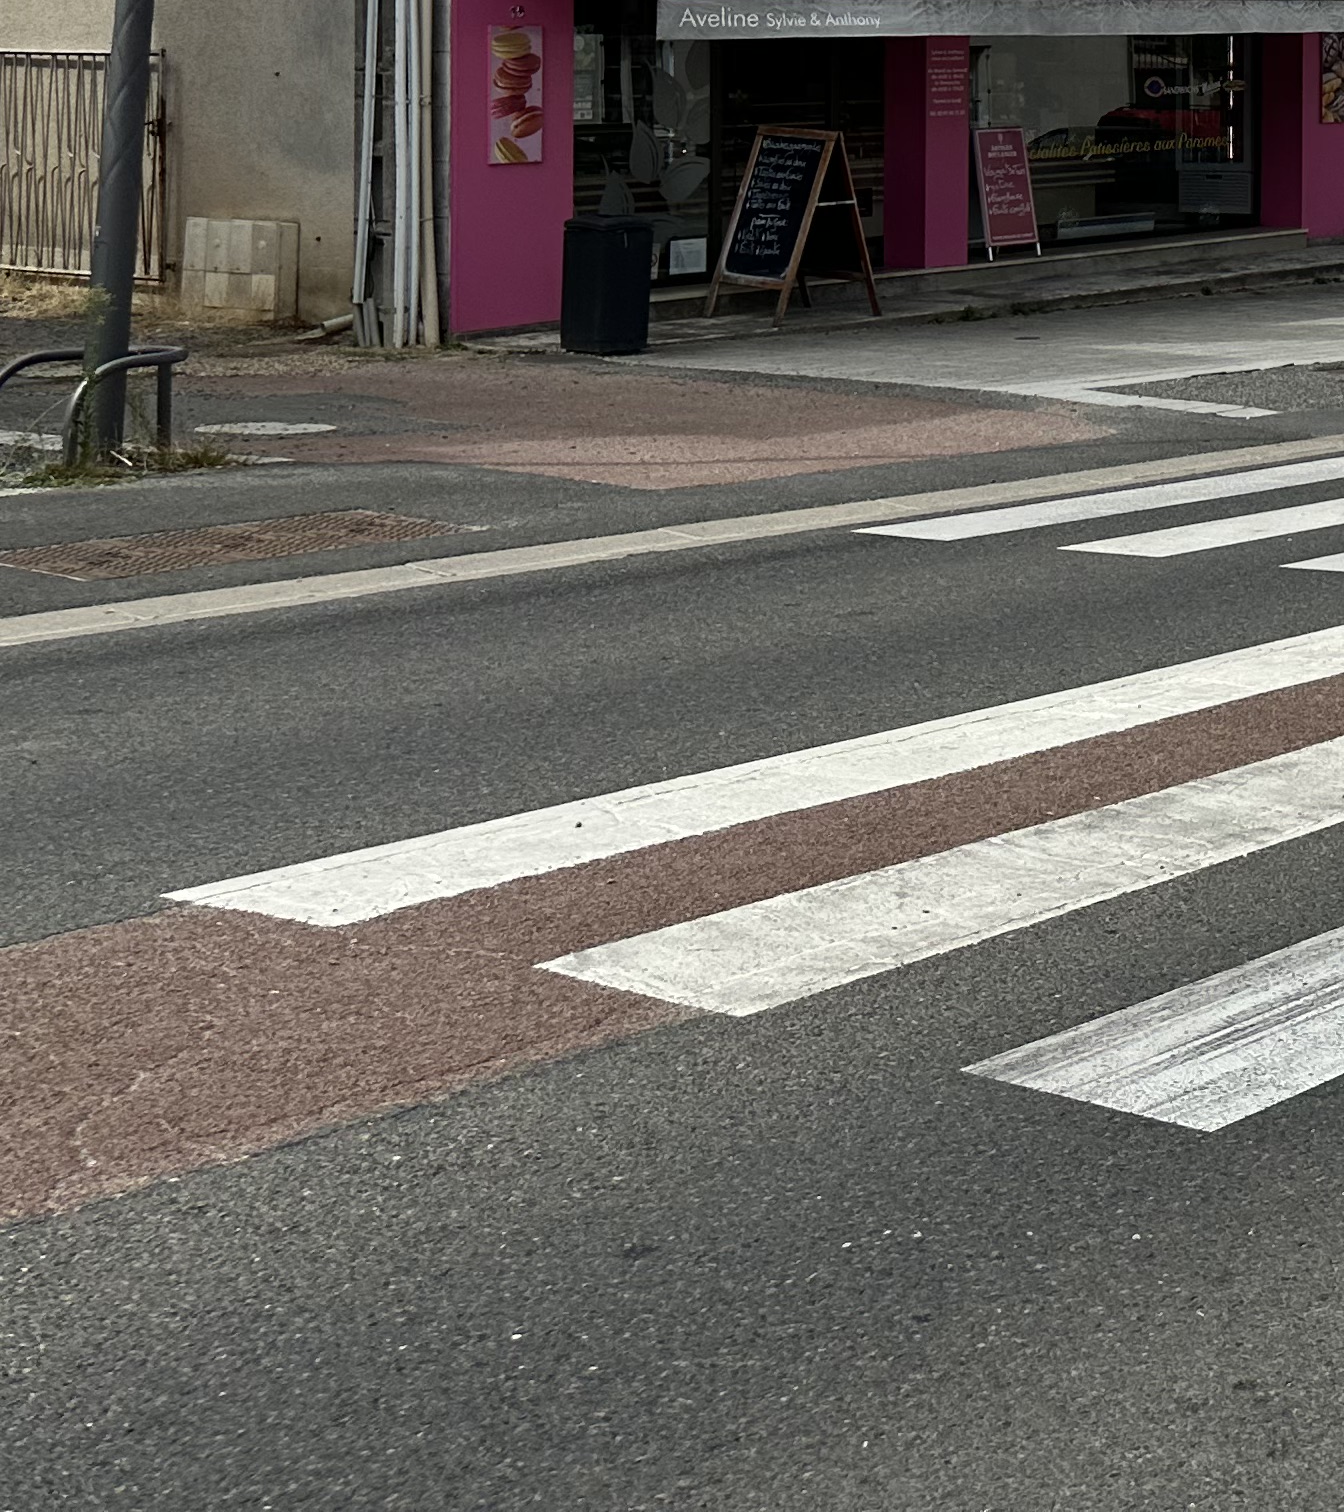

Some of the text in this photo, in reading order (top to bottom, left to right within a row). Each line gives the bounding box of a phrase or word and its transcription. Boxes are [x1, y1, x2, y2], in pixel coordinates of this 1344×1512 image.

[679, 7, 880, 29] Aveline Sylvie & Anthony
